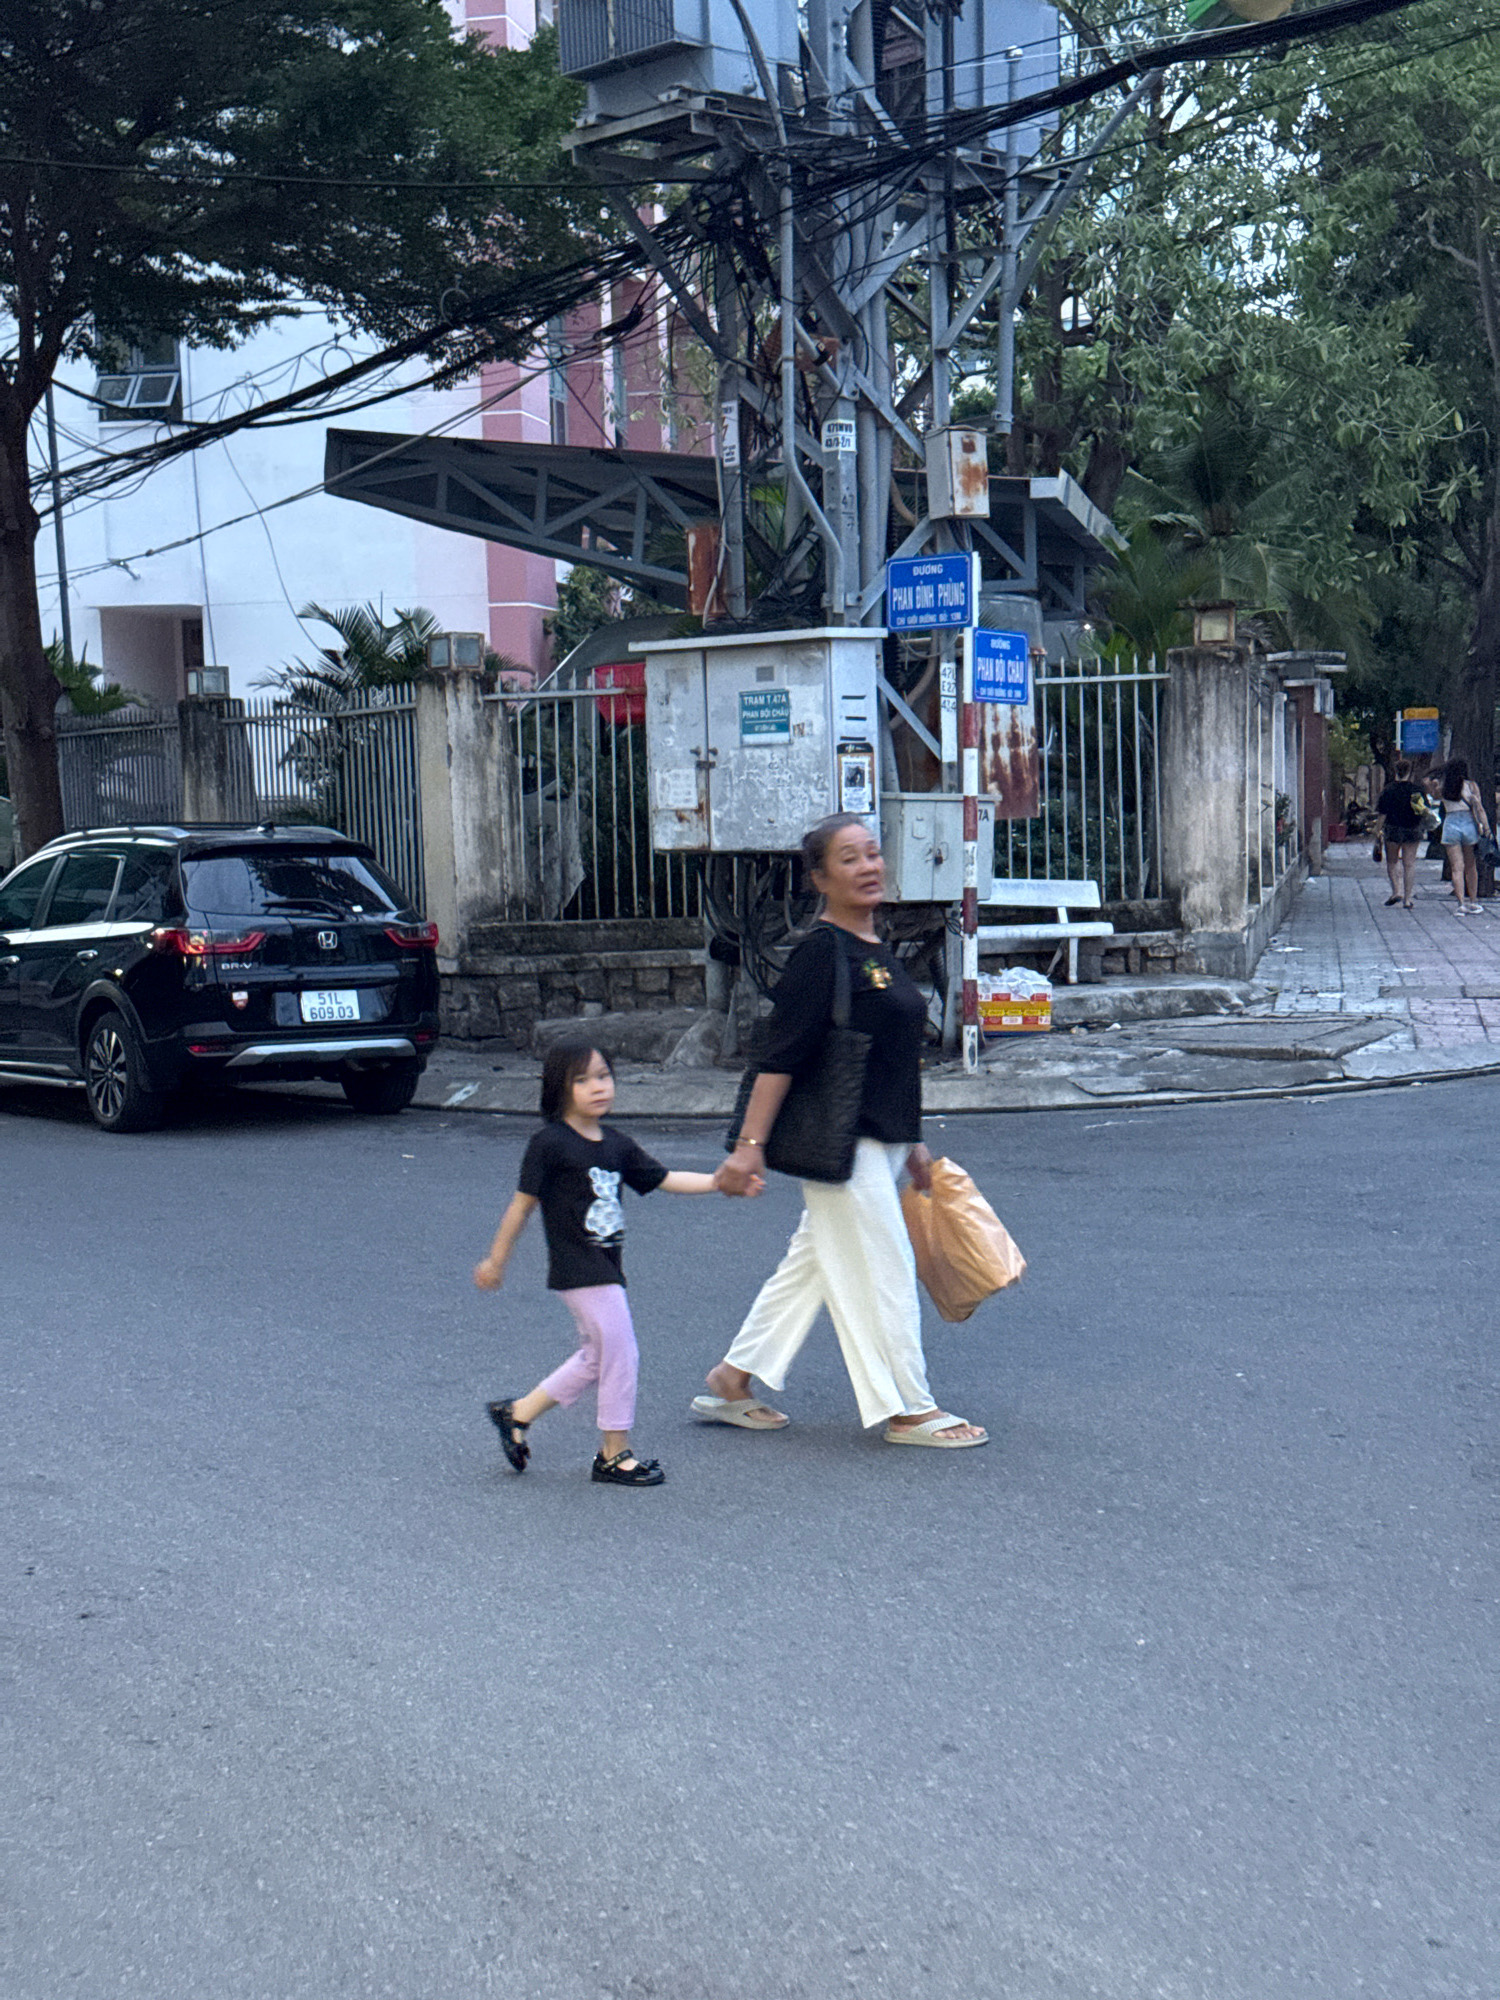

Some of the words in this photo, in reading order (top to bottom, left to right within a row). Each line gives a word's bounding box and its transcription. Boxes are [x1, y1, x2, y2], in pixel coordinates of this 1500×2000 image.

[892, 586, 914, 611] PHAN
[916, 580, 934, 609] ĐÌNH
[938, 577, 965, 607] PHÙNG
[977, 656, 994, 681] PHAN
[995, 653, 1006, 686] BỘI
[1007, 655, 1024, 684] CHÂU
[318, 992, 343, 1005] 51L
[309, 1006, 354, 1020] 609.03
